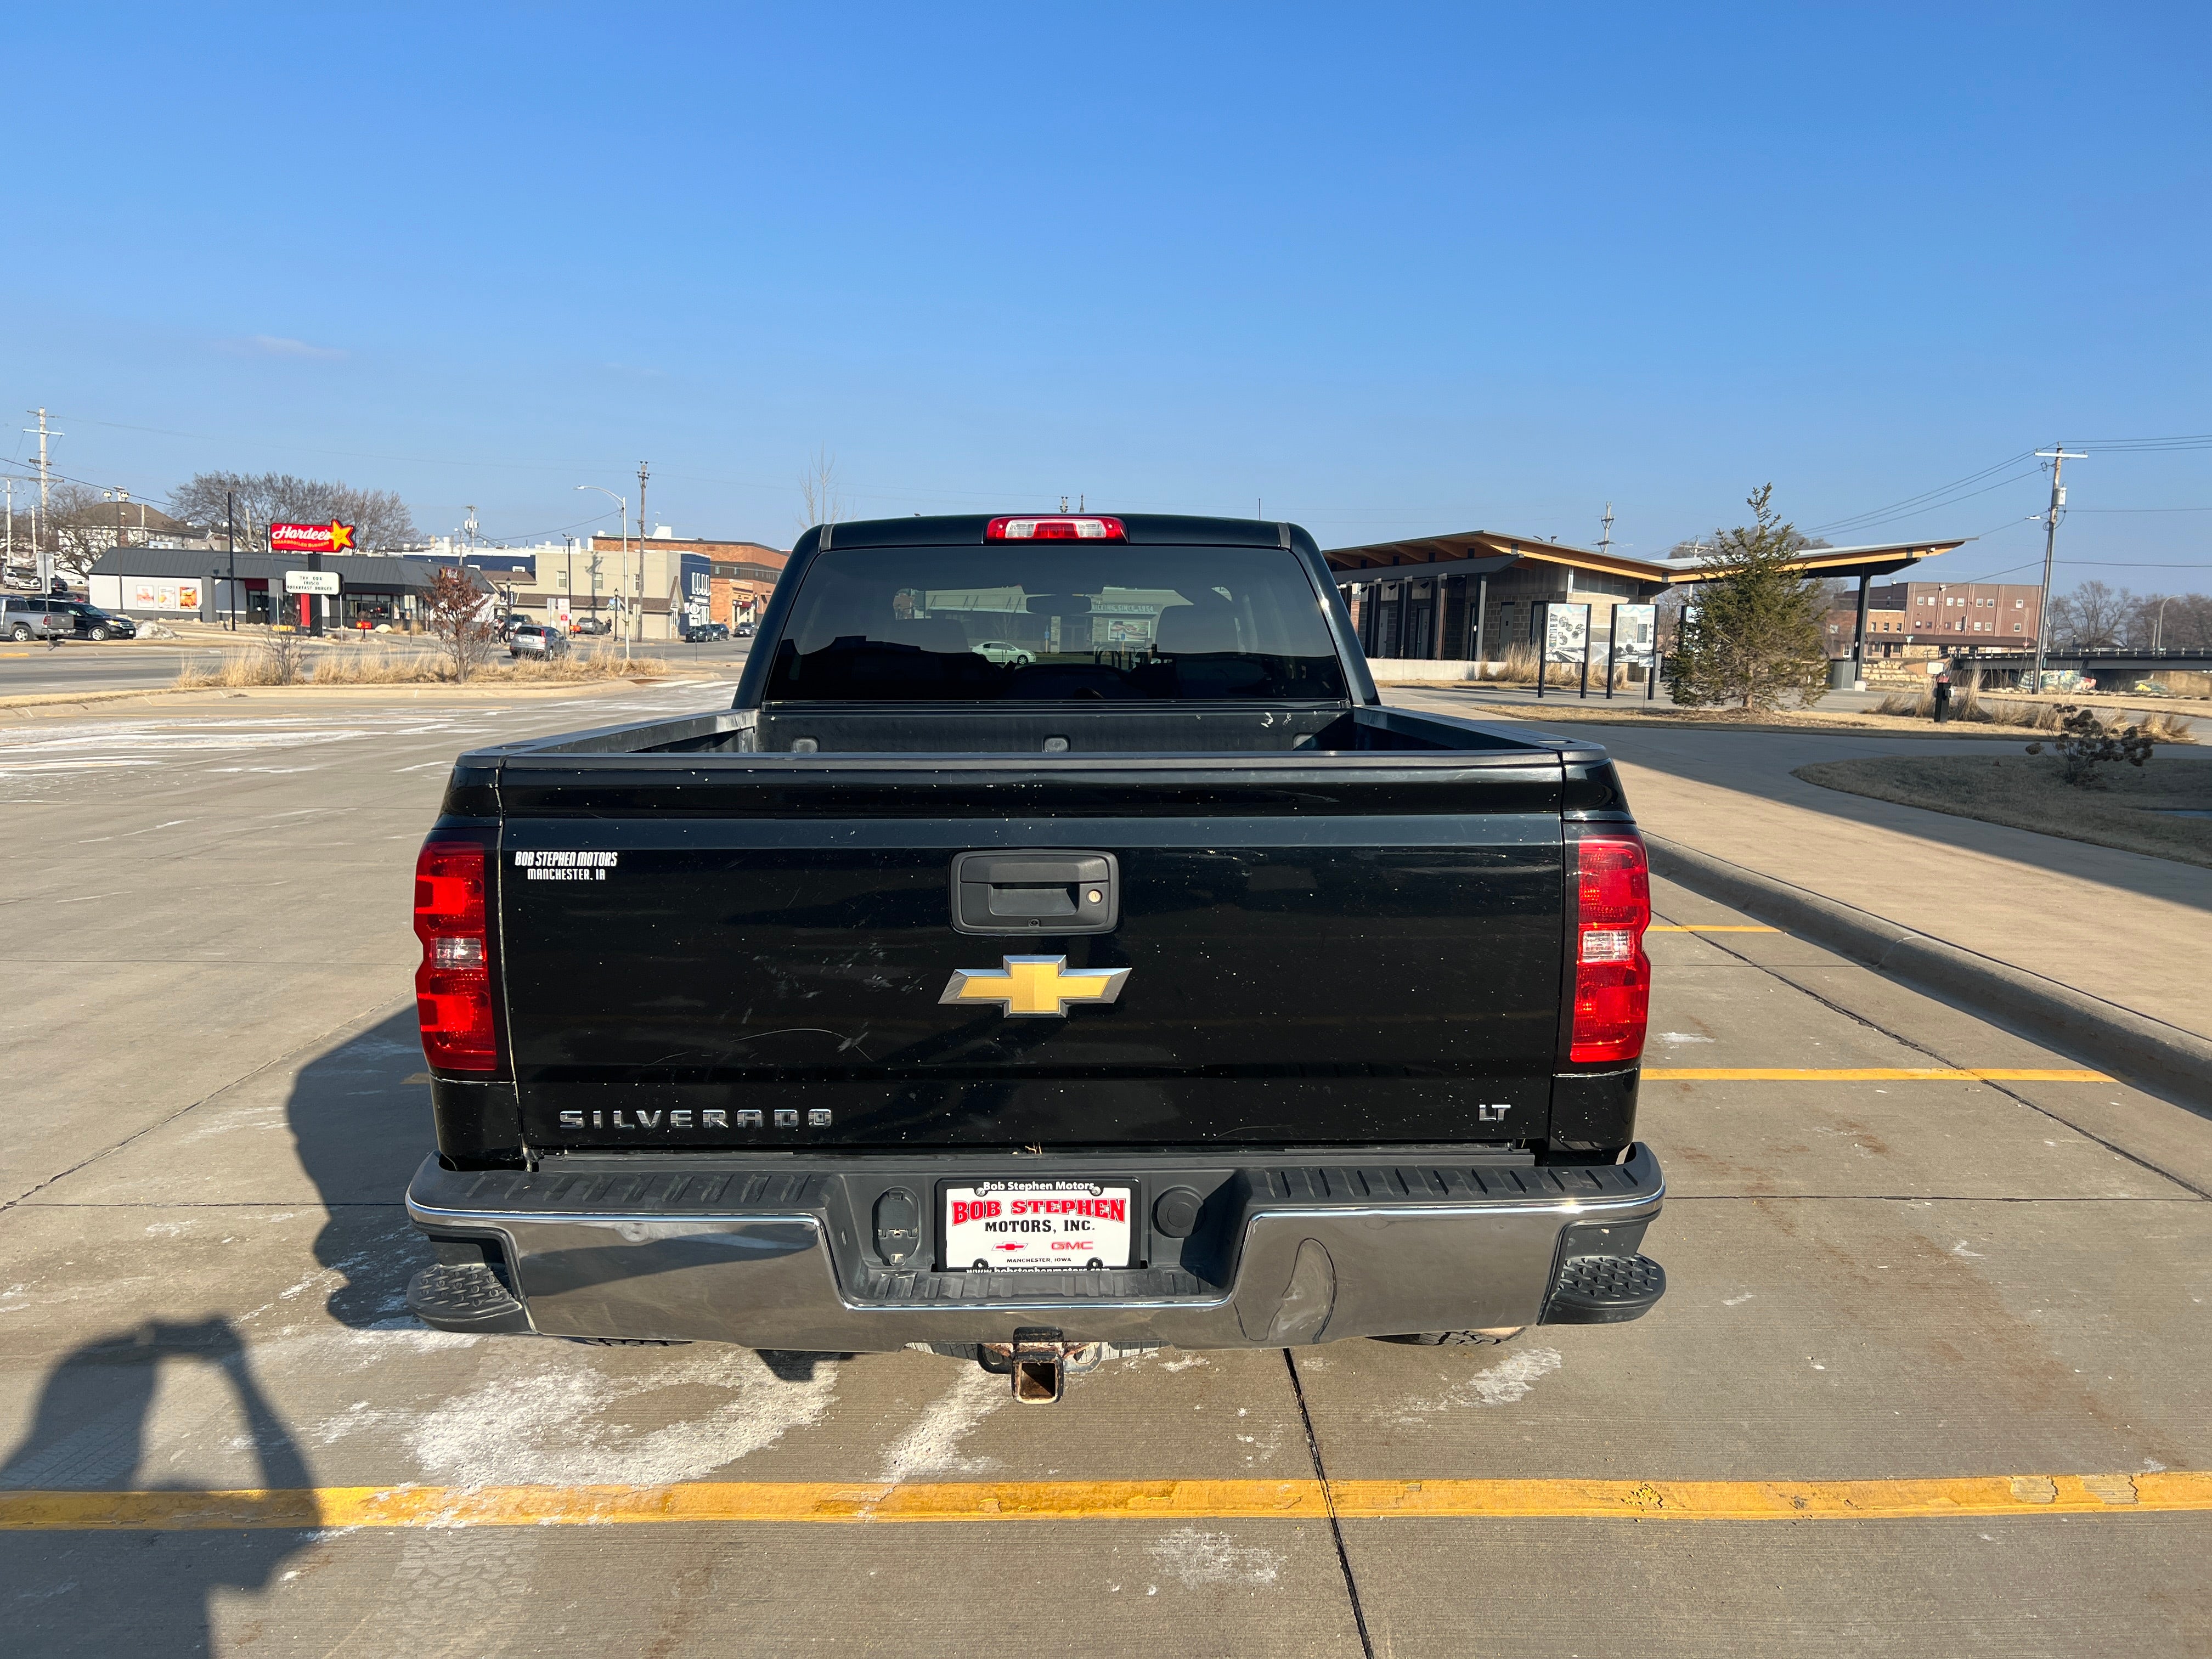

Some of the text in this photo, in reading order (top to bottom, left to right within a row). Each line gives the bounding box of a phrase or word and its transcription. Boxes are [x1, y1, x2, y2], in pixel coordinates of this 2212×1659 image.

[272, 526, 331, 540] Hardee's
[515, 851, 618, 867] BOB STEPHEN MOTORS
[595, 868, 606, 881] IA
[560, 1109, 832, 1128] SILVERADO
[1479, 1104, 1511, 1121] LT
[983, 1181, 1094, 1192] Bob Stephen Motors
[951, 1198, 1126, 1227] BOB STEPHEN
[985, 1219, 1096, 1234] MOTORS, INC.
[1051, 1241, 1094, 1250] GMC
